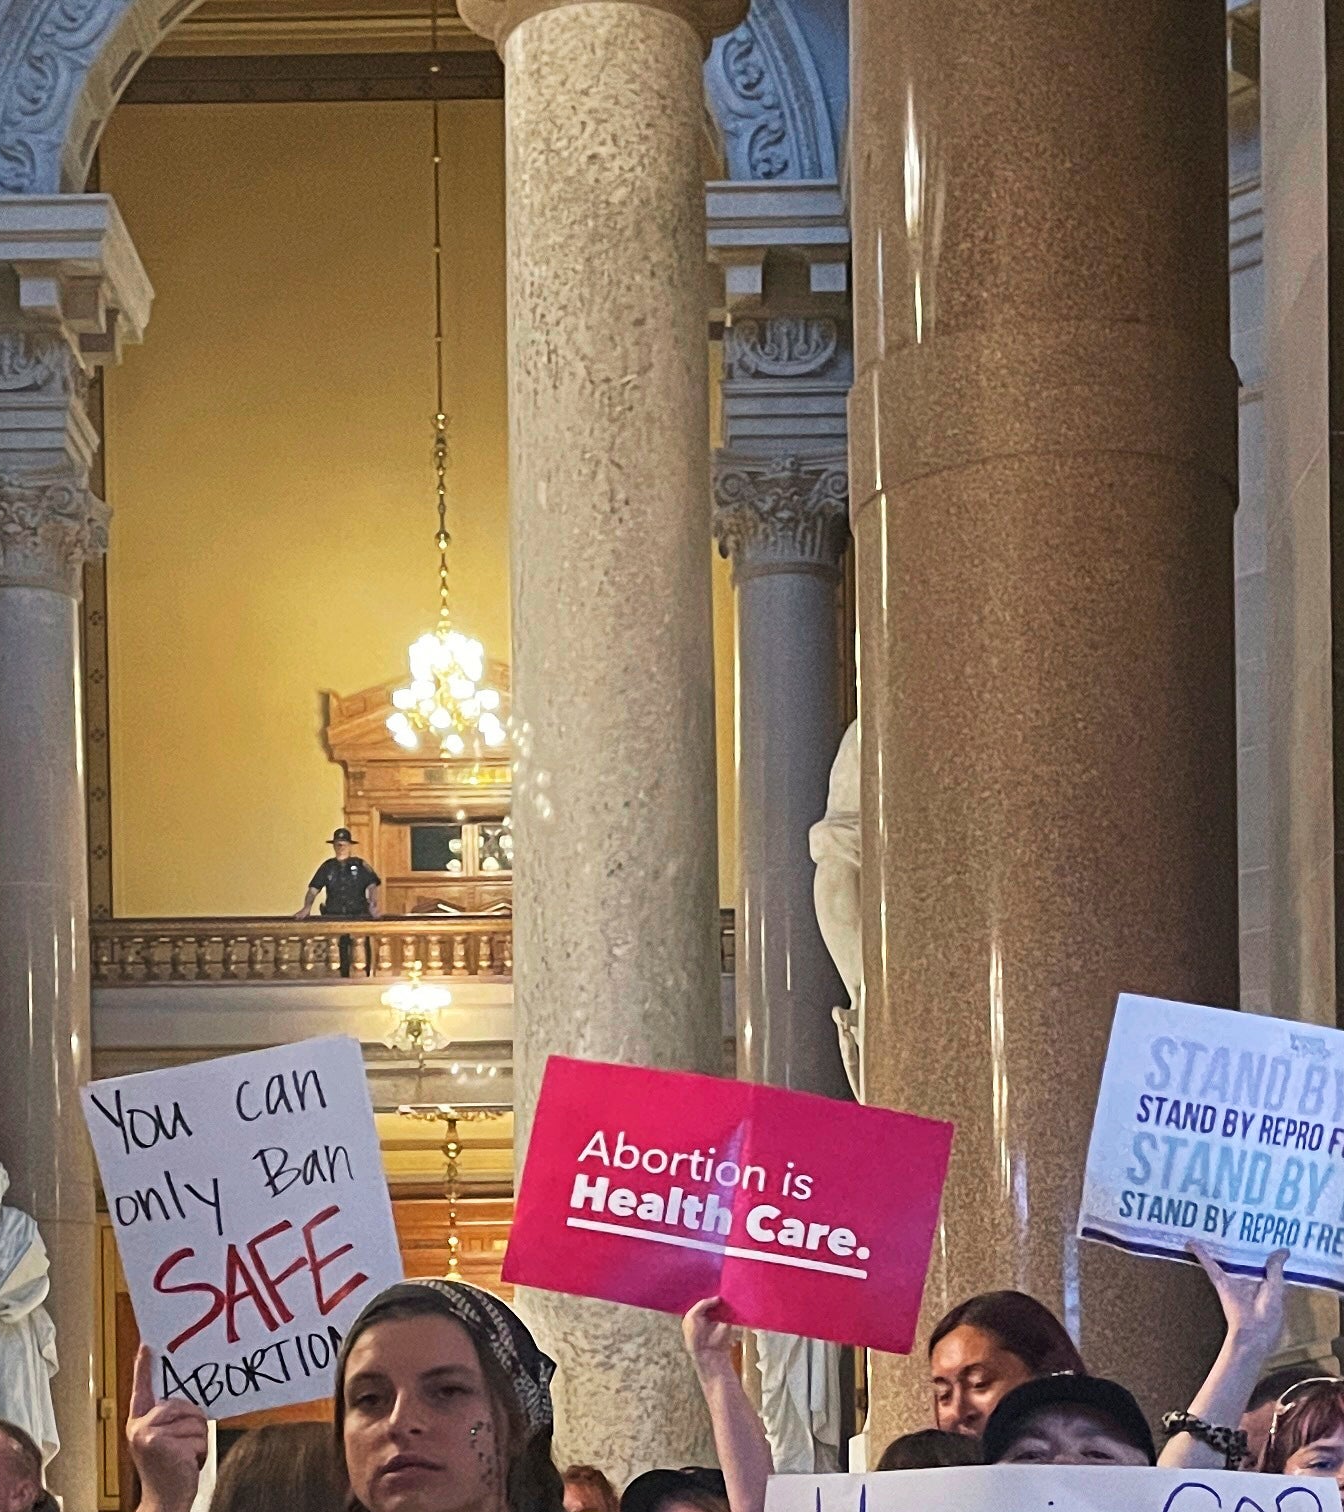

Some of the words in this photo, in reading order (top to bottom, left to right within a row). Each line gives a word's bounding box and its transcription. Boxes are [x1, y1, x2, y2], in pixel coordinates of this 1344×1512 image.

[91, 1089, 192, 1154] You
[236, 1068, 327, 1122] can
[1145, 1036, 1292, 1111] STAND
[577, 1130, 766, 1192] Abortion
[782, 1161, 814, 1199] is
[1136, 1094, 1217, 1134] STAND
[1221, 1108, 1256, 1140] BY
[1258, 1116, 1325, 1153] REPRO
[115, 1170, 224, 1236] only
[252, 1145, 354, 1198] Ban
[570, 1174, 732, 1236] Health
[745, 1204, 871, 1260] Care.
[1126, 1131, 1273, 1205] STAND
[1275, 1154, 1334, 1217] BY
[1118, 1190, 1198, 1229] STAND
[1203, 1206, 1237, 1241] BY
[1239, 1212, 1300, 1248] REPRO
[153, 1205, 369, 1354] SAFE
